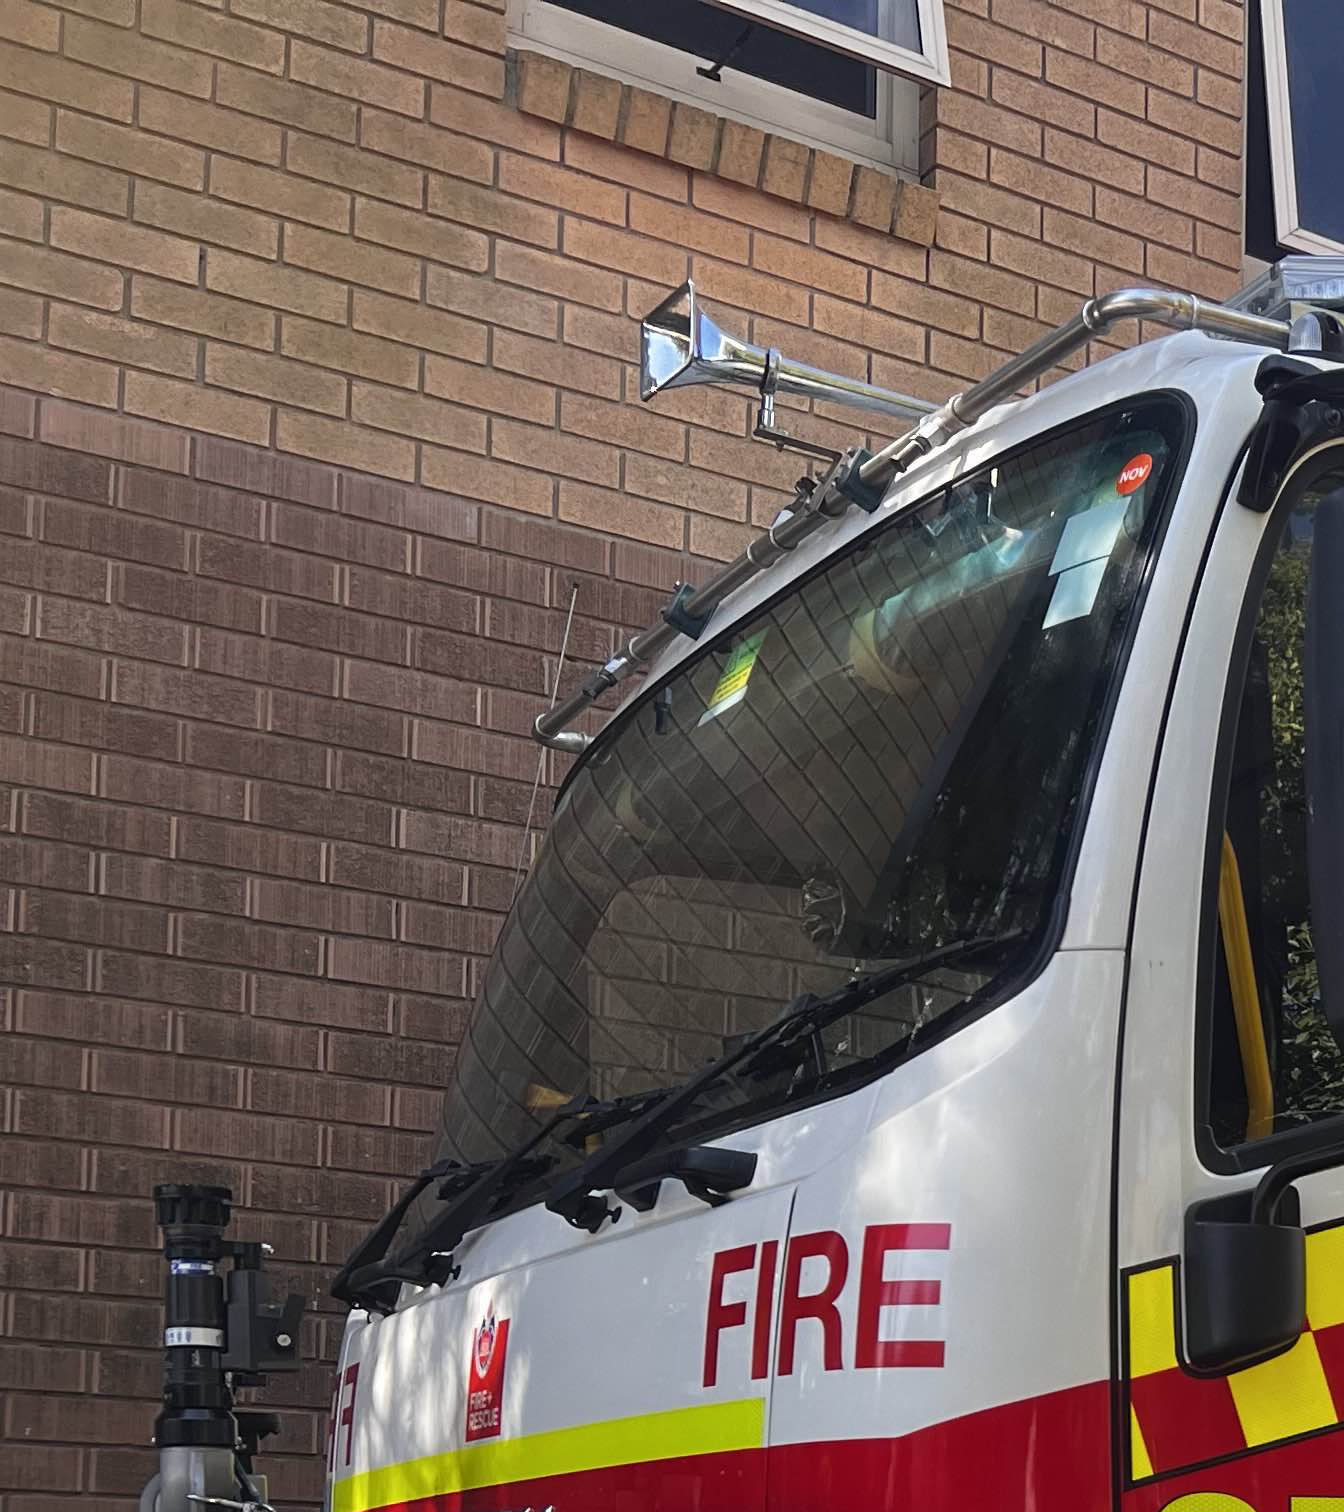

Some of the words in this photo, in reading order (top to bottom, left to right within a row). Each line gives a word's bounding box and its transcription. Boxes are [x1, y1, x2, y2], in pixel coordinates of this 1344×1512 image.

[1119, 464, 1149, 484] NOV
[703, 1223, 951, 1388] FIRE
[469, 1408, 499, 1432] RESCUE
